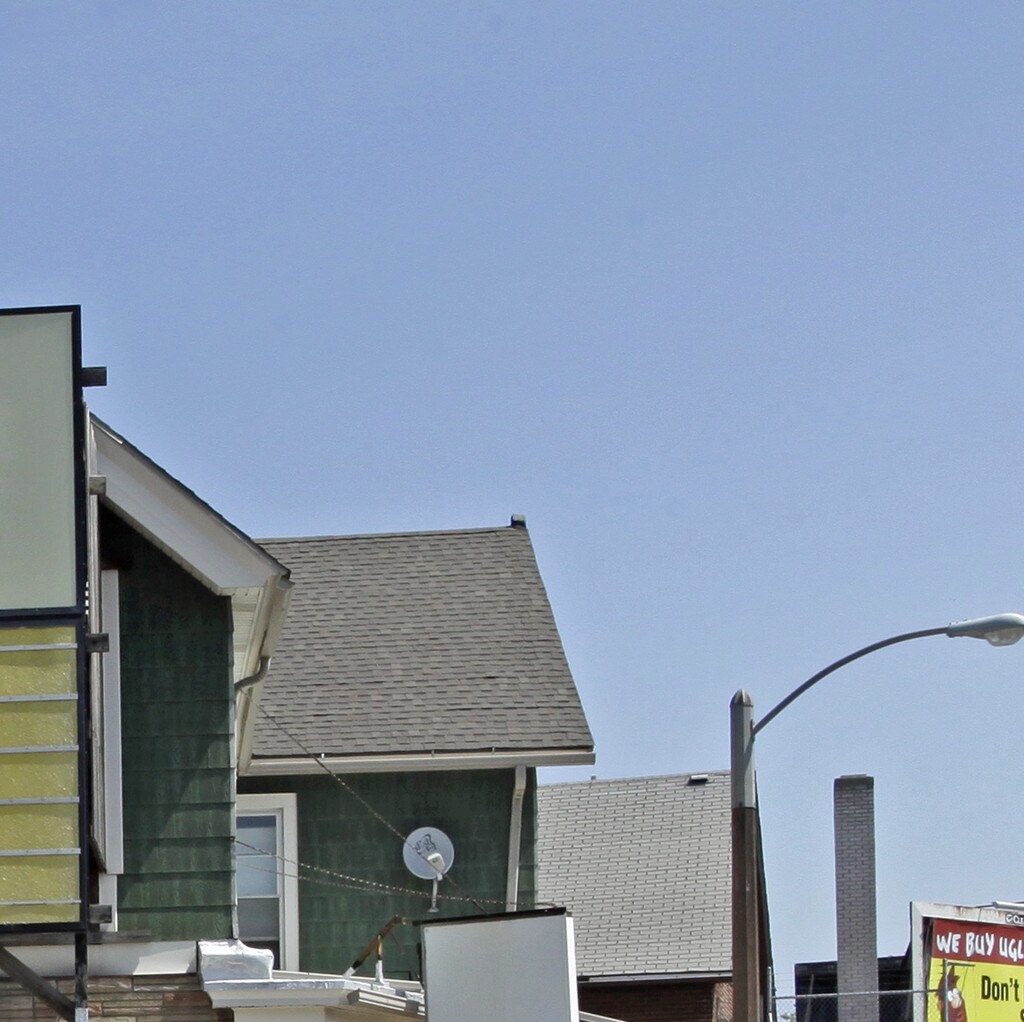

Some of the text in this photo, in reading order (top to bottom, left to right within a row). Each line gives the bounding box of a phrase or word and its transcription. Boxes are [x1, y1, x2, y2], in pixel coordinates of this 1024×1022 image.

[936, 932, 961, 954] WE
[965, 932, 995, 958] BUY
[981, 975, 1019, 1003] Don't
